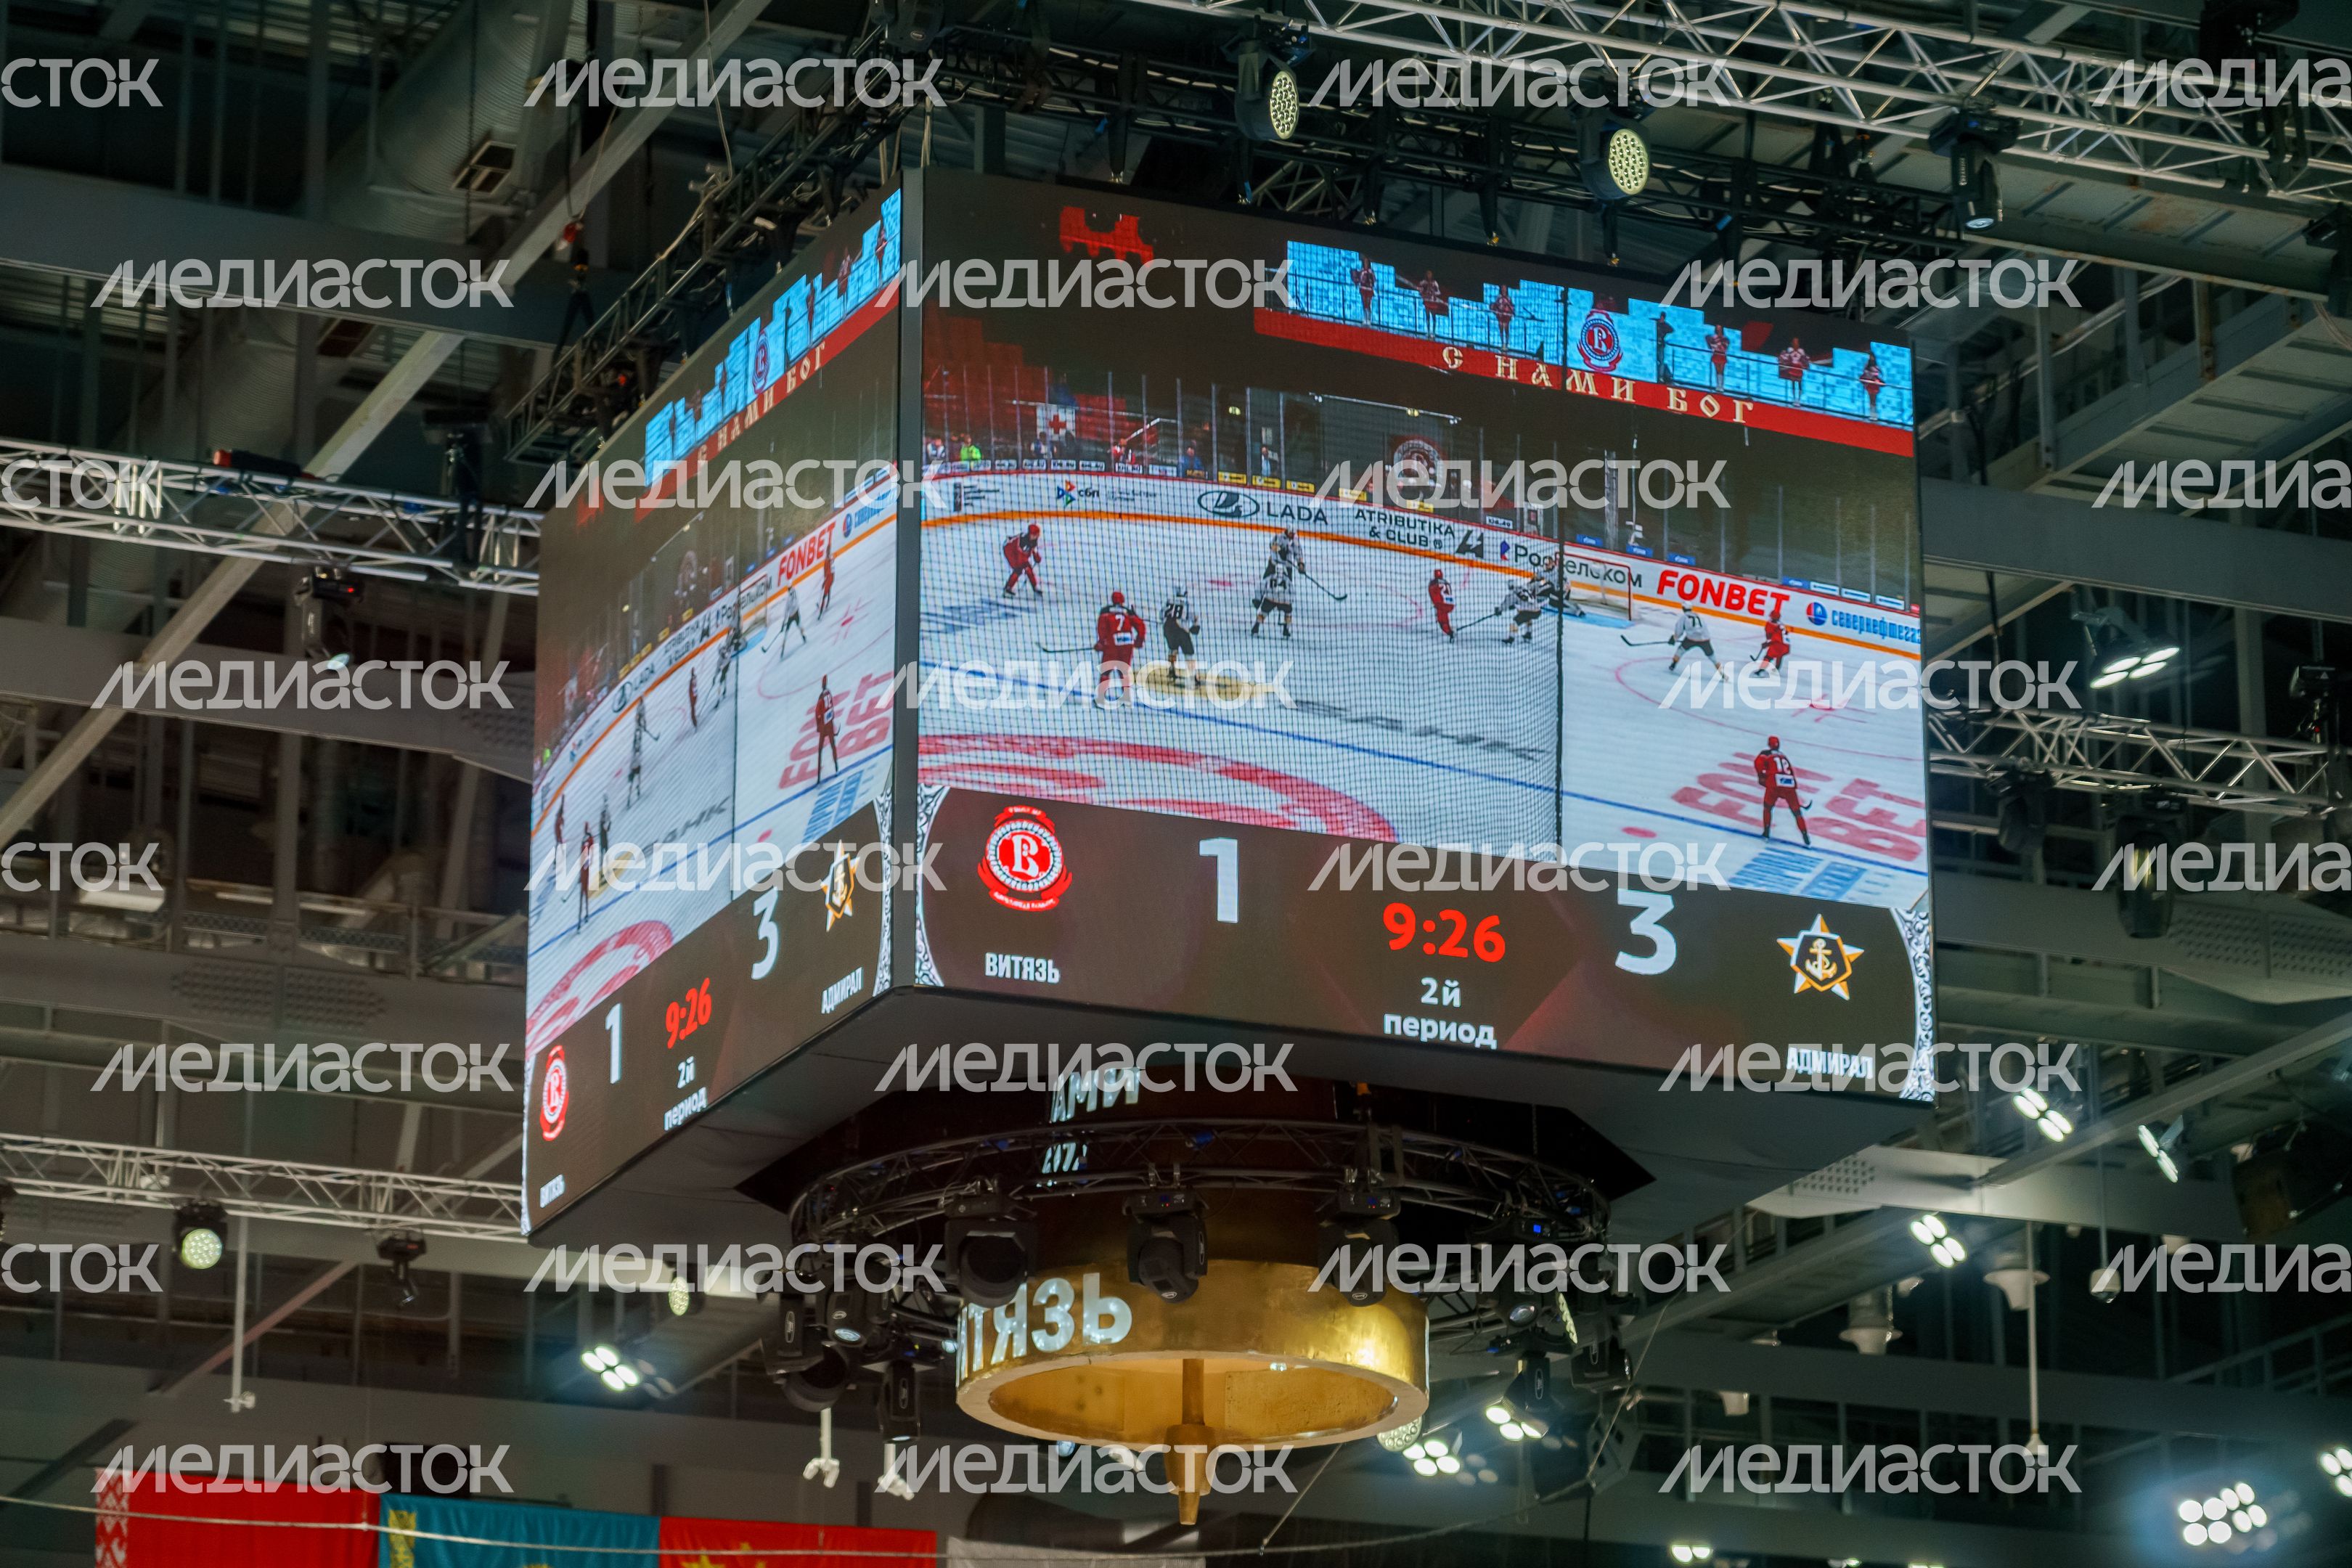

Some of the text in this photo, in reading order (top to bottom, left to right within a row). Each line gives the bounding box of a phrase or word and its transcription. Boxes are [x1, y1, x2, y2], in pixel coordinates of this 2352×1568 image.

[1495, 355, 1635, 403] НАМИ
[1667, 387, 1754, 424] БОГ
[1267, 500, 1328, 526] LADA
[1355, 509, 1455, 539] ATRIBUTIKA
[777, 520, 836, 587] FONBET
[1386, 529, 1429, 547] CLUB
[1514, 544, 1642, 588] Роелком
[1657, 569, 1790, 616] FONBET
[1199, 837, 1238, 923] 1
[751, 886, 779, 980] 3
[1383, 902, 1506, 963] 9:26
[1615, 888, 1677, 976] 3
[821, 966, 864, 1014] АДМИРАЛ
[985, 952, 1061, 984] ВИТЯЗЬ
[666, 977, 712, 1050] 9:26
[1421, 977, 1461, 1007] 2й
[605, 1003, 622, 1085] 1
[1384, 1013, 1498, 1050] период
[1787, 1046, 1875, 1079] АДМИРАЛ
[663, 1087, 709, 1132] период
